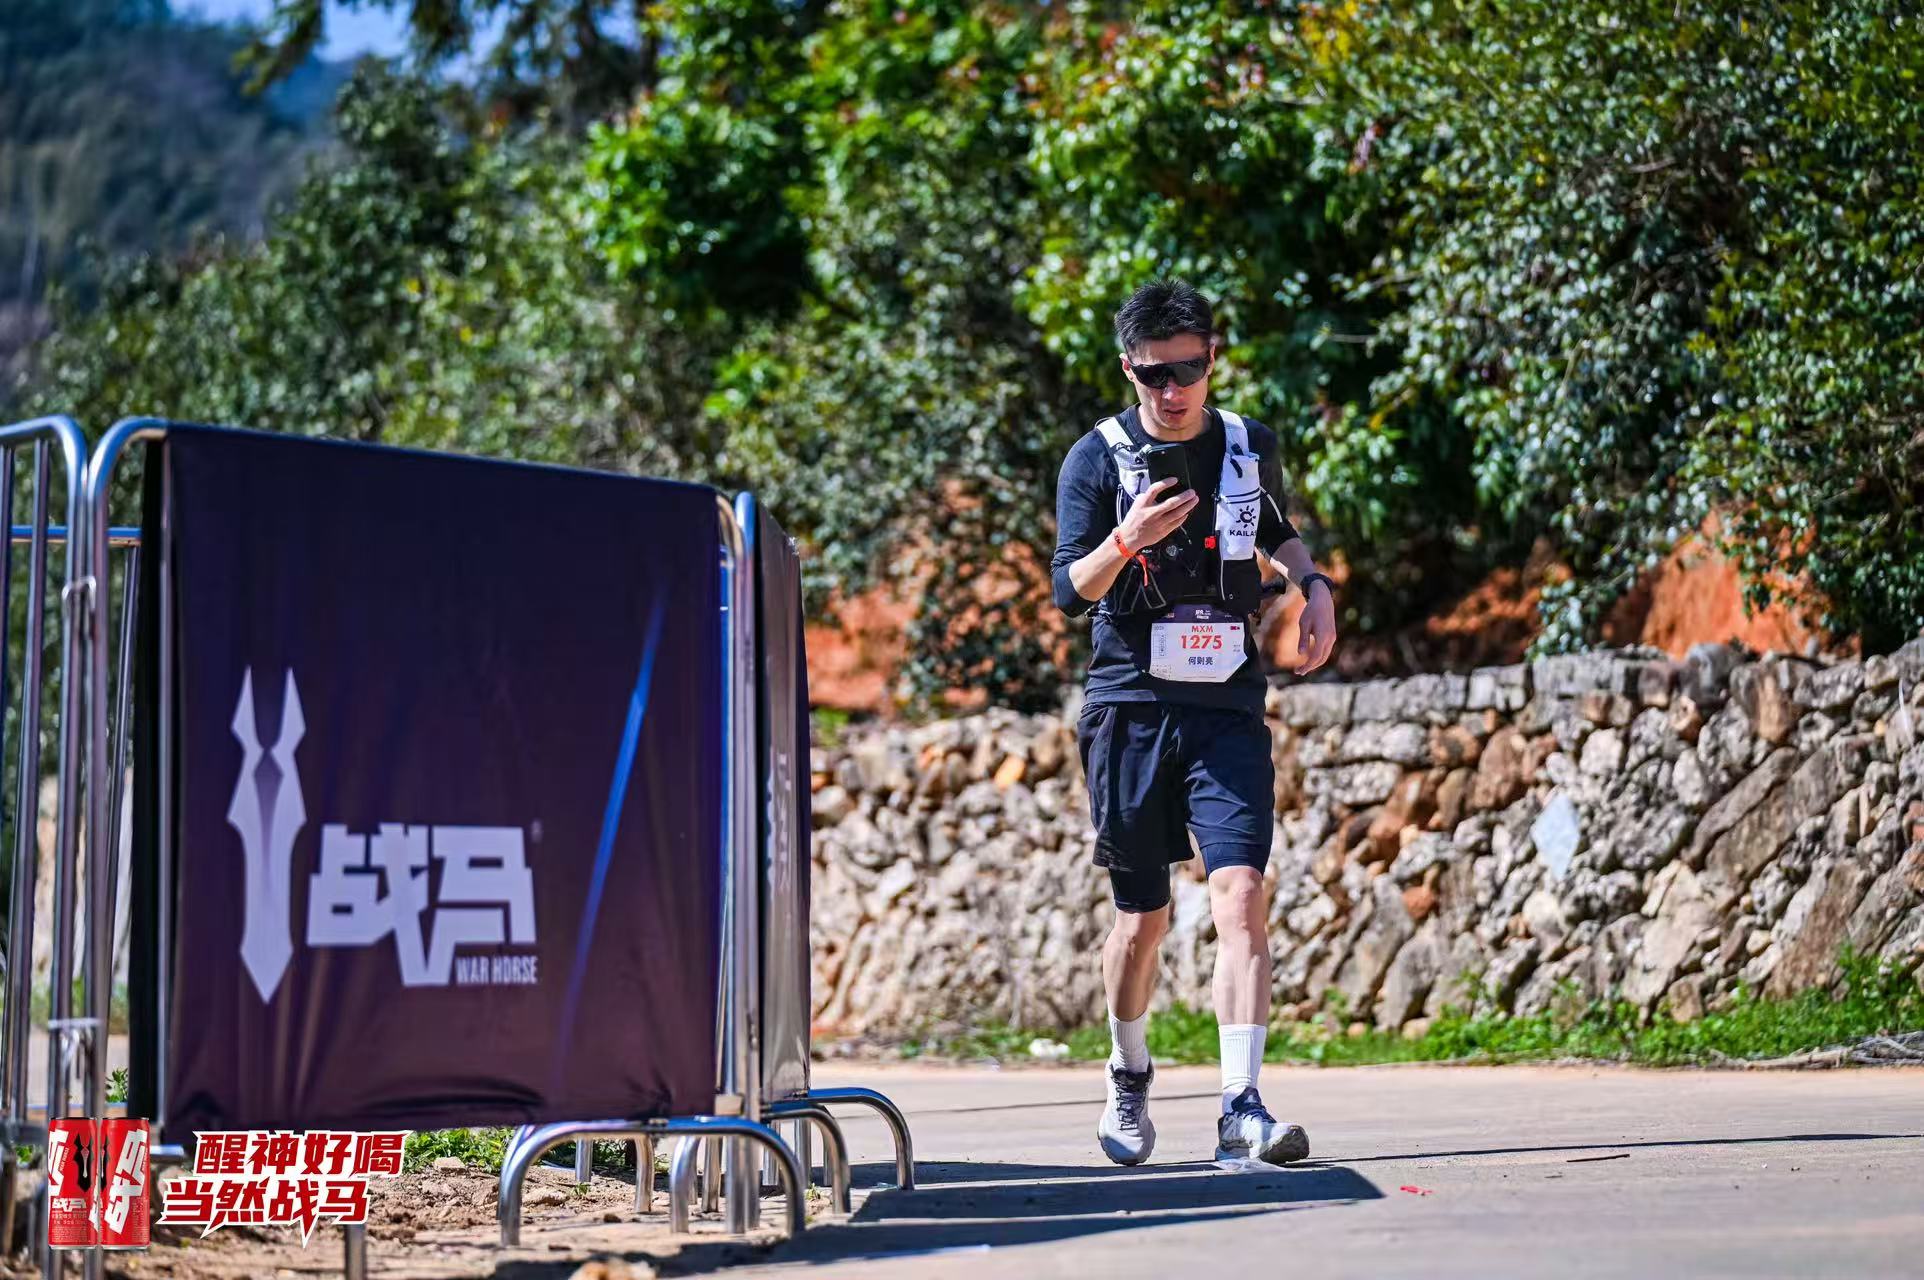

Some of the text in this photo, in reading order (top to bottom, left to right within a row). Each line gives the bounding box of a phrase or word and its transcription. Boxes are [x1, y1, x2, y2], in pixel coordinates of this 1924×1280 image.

[1191, 625, 1214, 633] MXM
[1180, 634, 1223, 650] 1275
[306, 822, 537, 987] 战马
[455, 956, 538, 985] WAR HORSE
